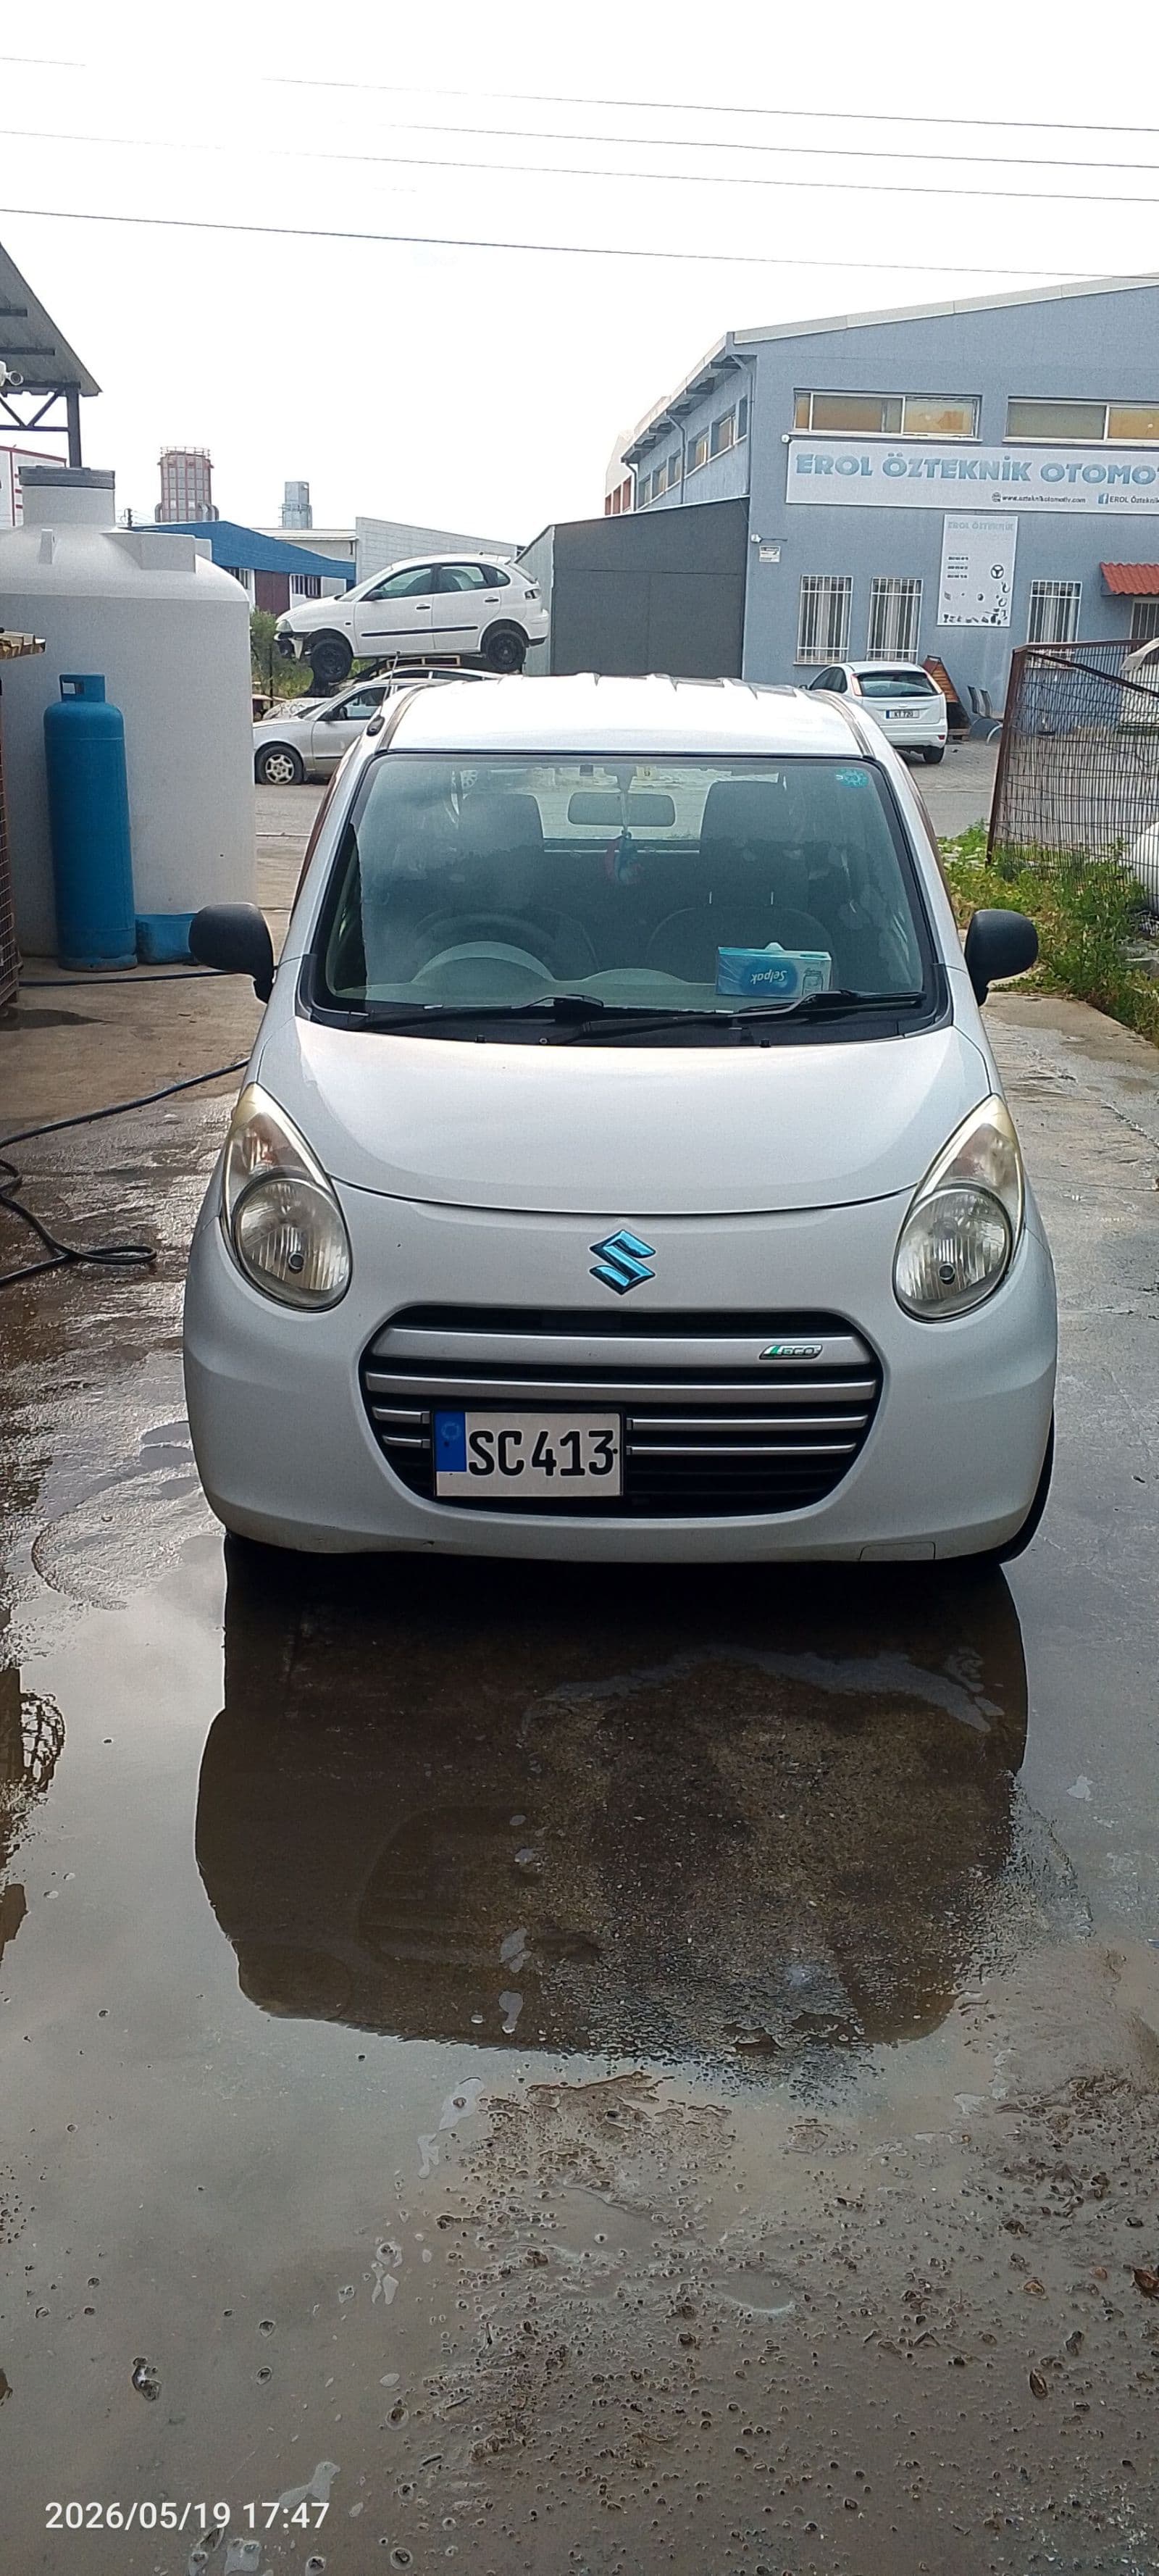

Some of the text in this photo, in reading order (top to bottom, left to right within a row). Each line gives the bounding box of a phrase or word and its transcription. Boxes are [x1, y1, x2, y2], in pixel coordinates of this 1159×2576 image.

[796, 452, 1159, 485] EROL ÖZTEKNİK OTOMO
[750, 969, 787, 985] Selpak
